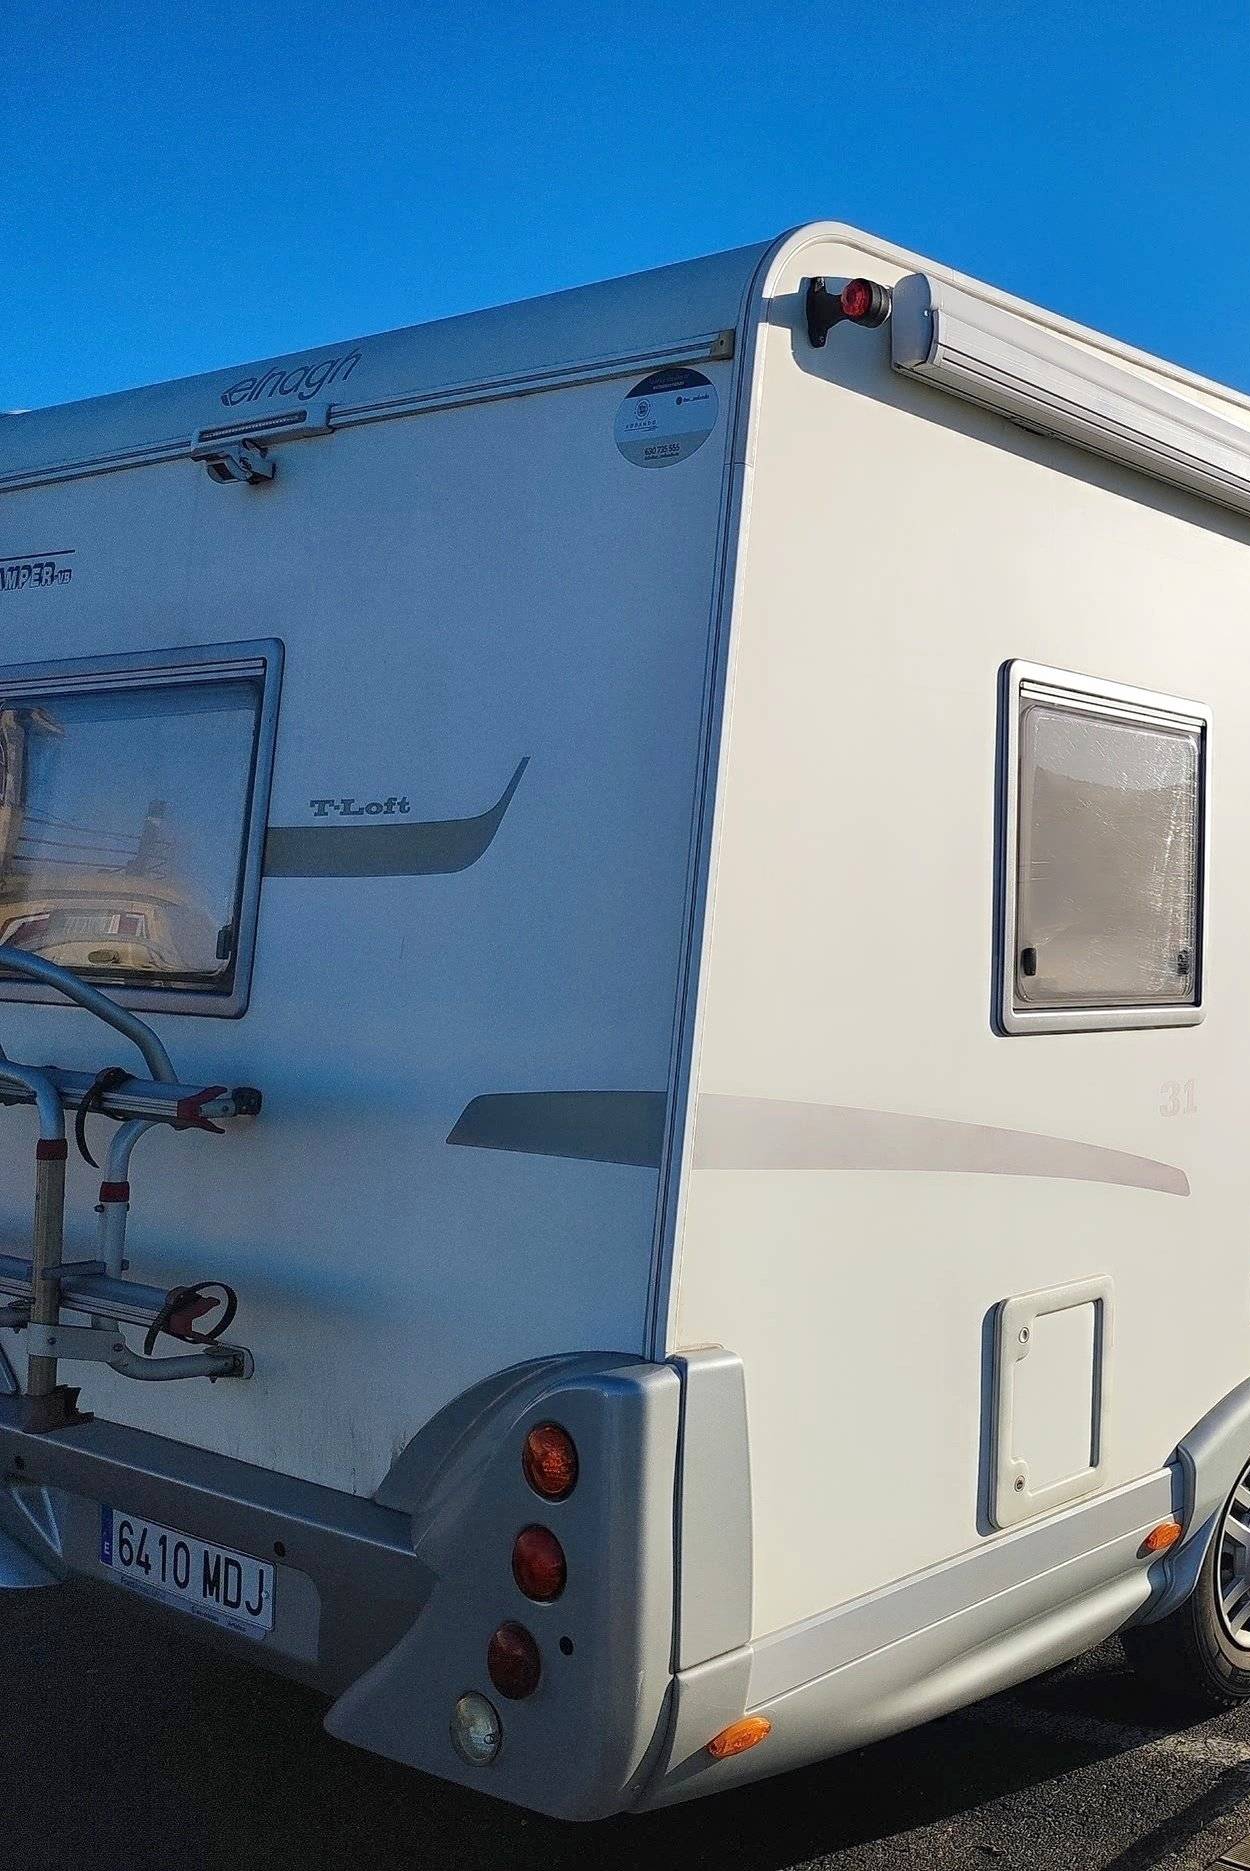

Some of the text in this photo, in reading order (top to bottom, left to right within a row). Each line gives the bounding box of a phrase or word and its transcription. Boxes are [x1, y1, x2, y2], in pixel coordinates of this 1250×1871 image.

[221, 347, 361, 407] elnagh
[310, 797, 410, 816] T-Loft
[1160, 1080, 1198, 1117] 31
[118, 1520, 191, 1589] 6410
[202, 1549, 264, 1616] MDJ
